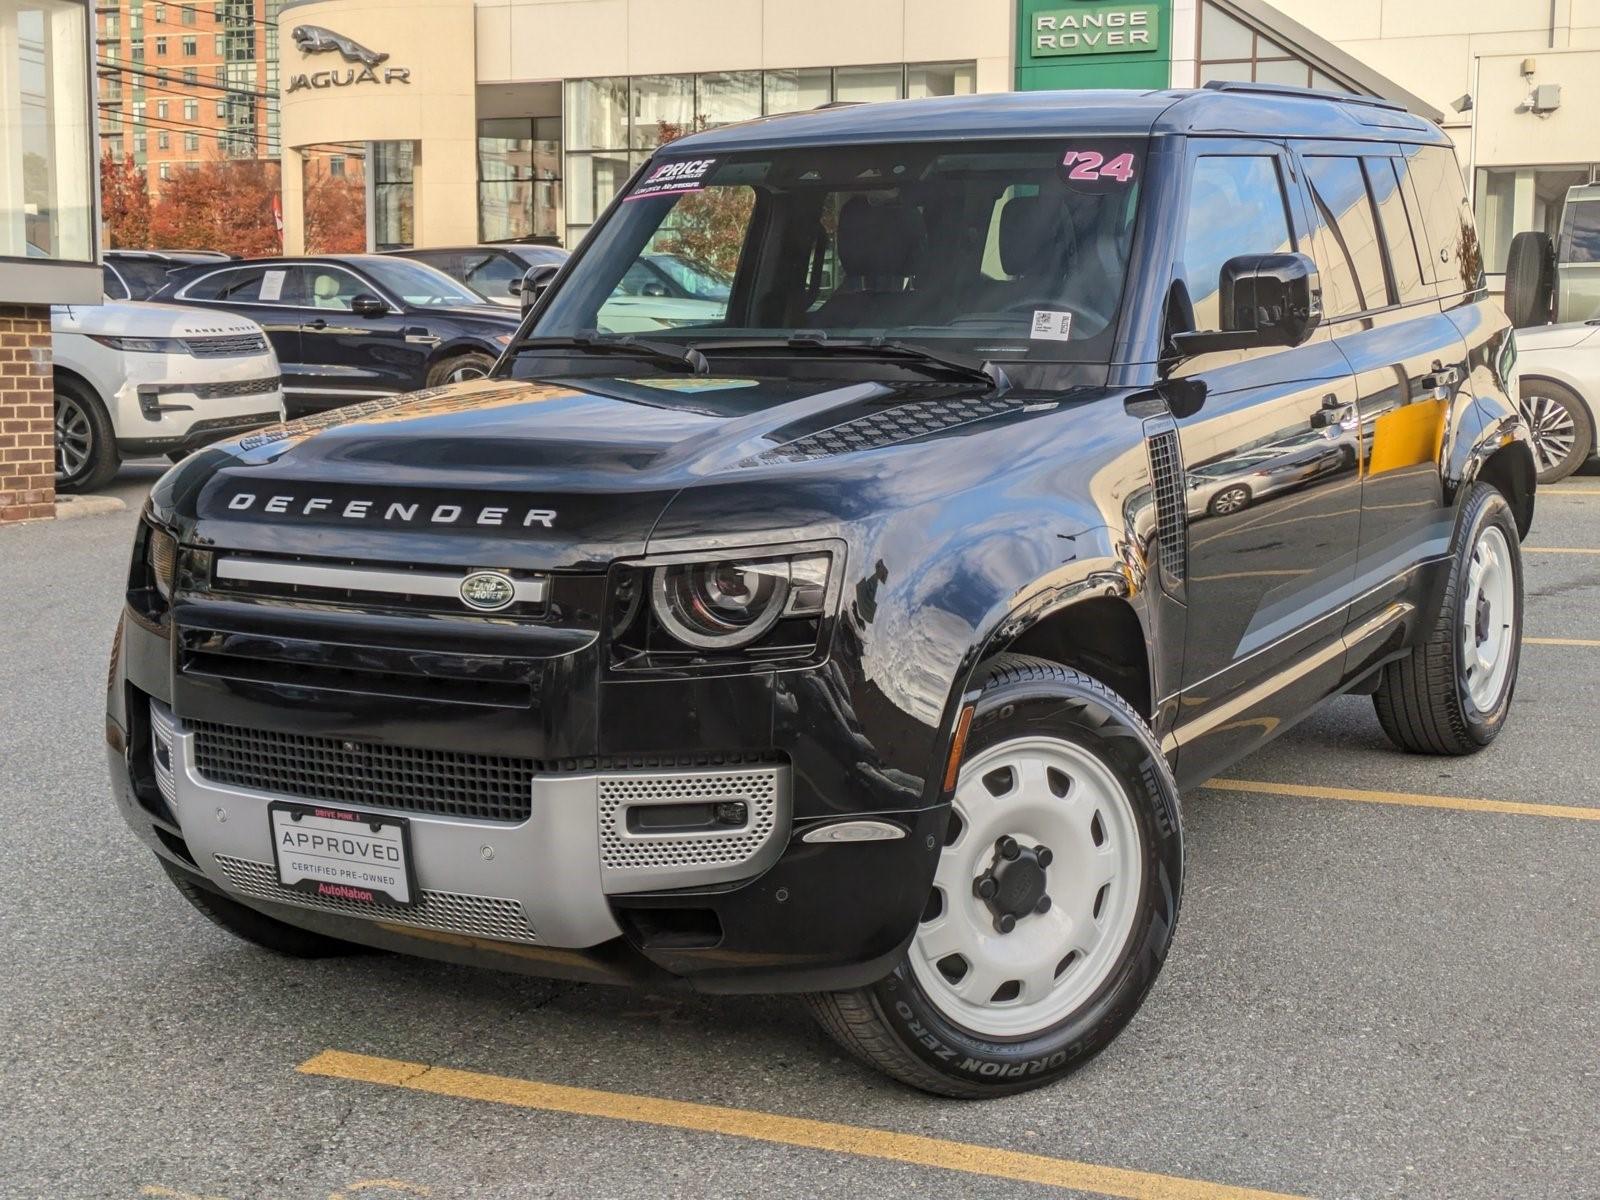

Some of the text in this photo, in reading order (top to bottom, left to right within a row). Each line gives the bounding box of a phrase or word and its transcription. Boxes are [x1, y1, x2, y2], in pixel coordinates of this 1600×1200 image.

[1037, 11, 1147, 30] RANGE
[1037, 30, 1149, 49] ROVER
[285, 64, 412, 94] JAGUAR
[1063, 151, 1134, 182] '24
[228, 493, 557, 527] DEFENDER
[315, 809, 336, 818] DRIVE
[282, 831, 399, 862] APPROVED
[292, 862, 395, 885] CERTIFIED PRE-OWNED
[318, 883, 373, 901] AutoNation
[895, 1000, 957, 1062] ZERO
